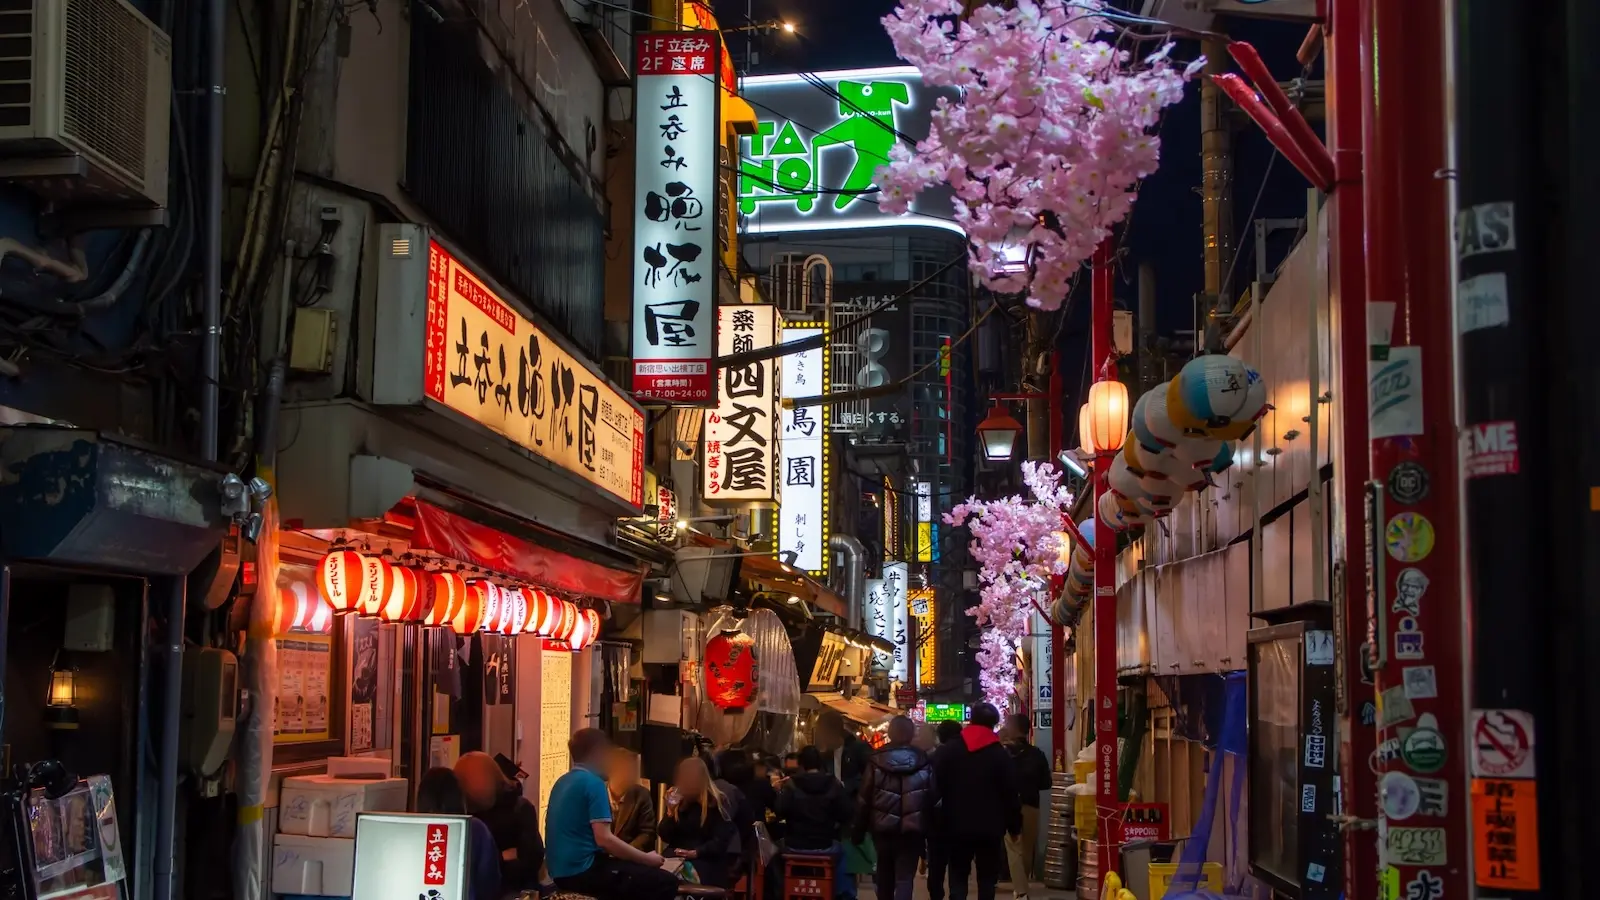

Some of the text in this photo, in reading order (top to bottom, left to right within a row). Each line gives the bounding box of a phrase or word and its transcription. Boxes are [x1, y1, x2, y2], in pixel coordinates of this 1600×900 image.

[642, 56, 705, 71] 2F 座席
[644, 38, 710, 52] 1F 立呑み
[644, 85, 703, 347] 立呑み 晩杯屋
[450, 316, 514, 421] 立呑み
[638, 364, 705, 374] 新宿思い出横丁店
[722, 361, 767, 492] 四文屋
[794, 513, 807, 553] 刺し身
[427, 828, 445, 881] 立呑み
